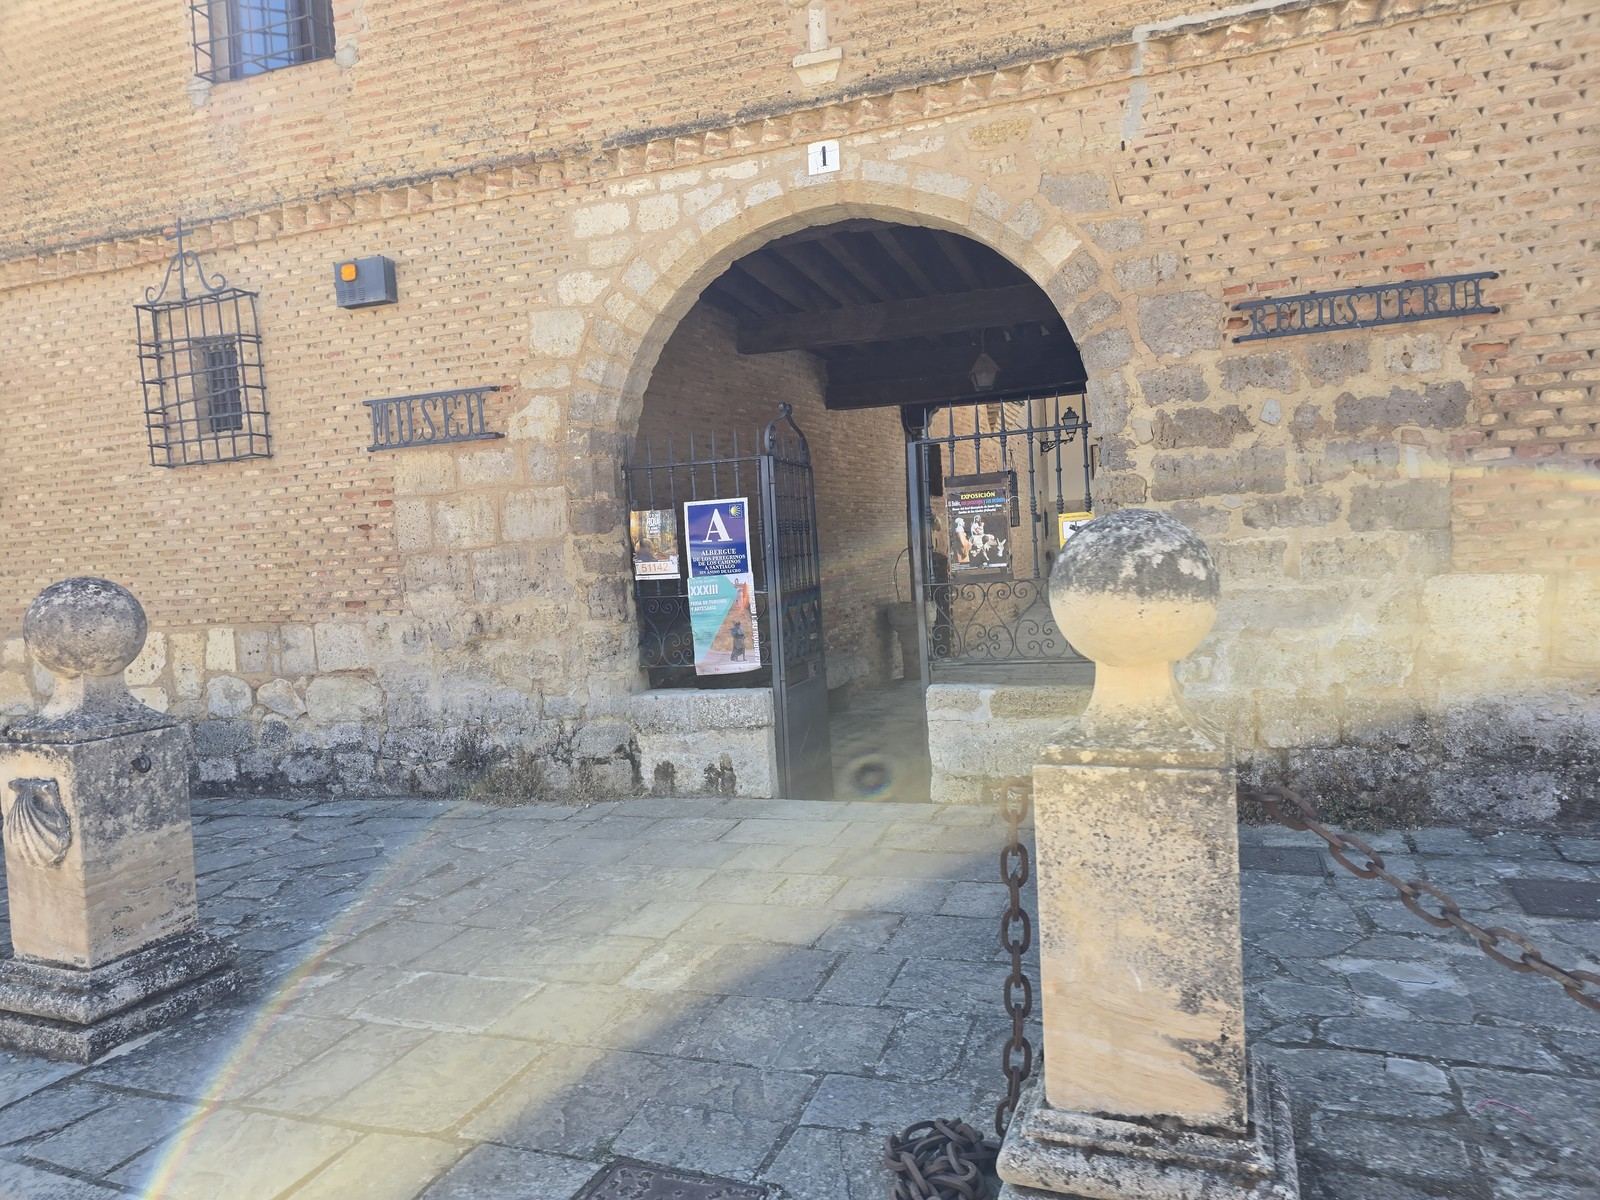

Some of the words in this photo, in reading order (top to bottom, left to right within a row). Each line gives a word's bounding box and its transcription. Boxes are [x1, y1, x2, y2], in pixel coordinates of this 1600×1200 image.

[960, 490, 996, 500] EXPOSICIÓN
[702, 508, 733, 543] A
[701, 548, 737, 556] ALBERGUE
[641, 563, 668, 573] 51142
[690, 584, 719, 596] XXXIII
